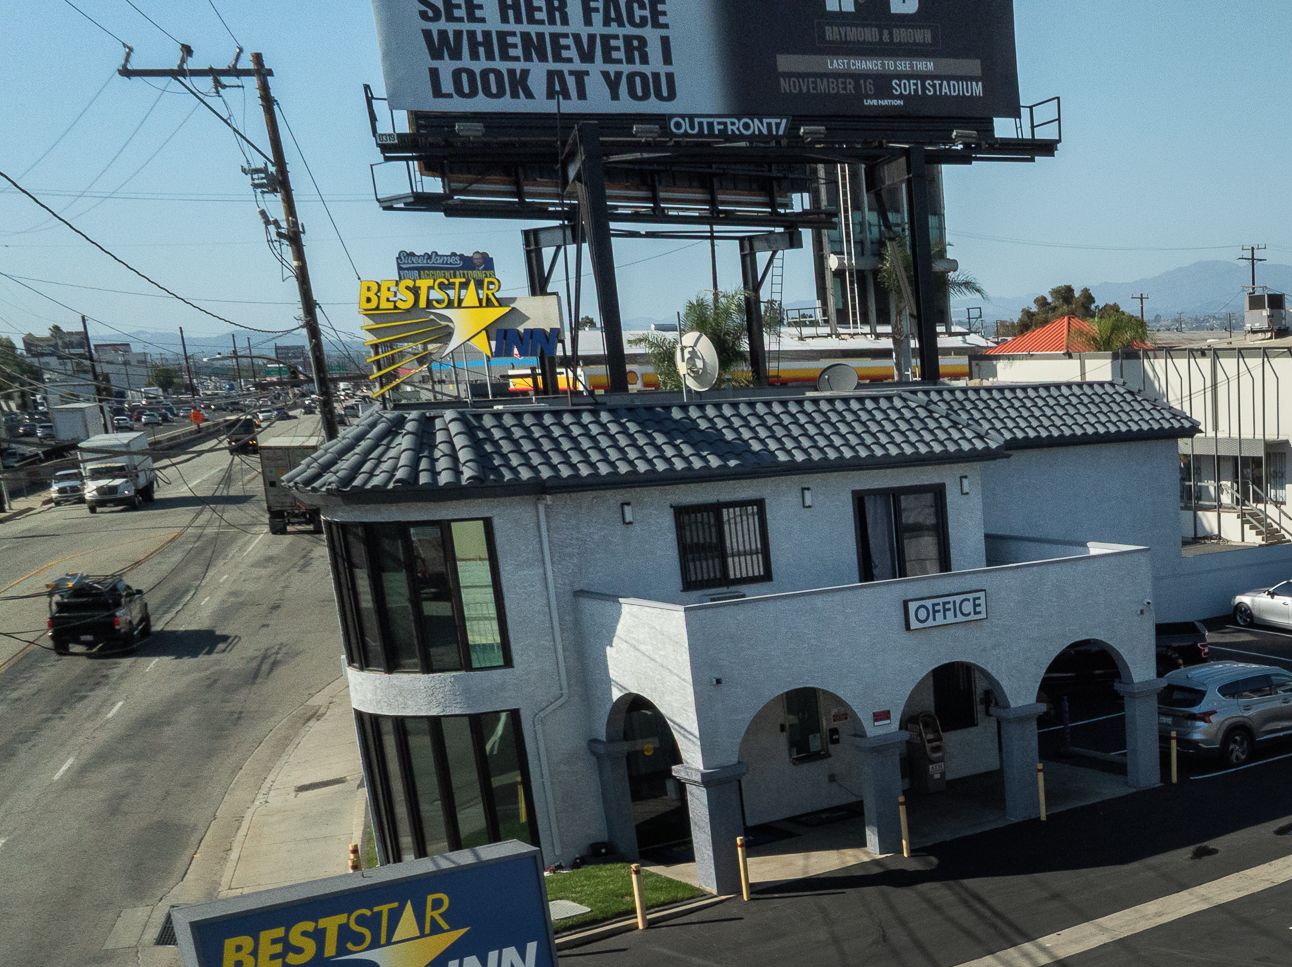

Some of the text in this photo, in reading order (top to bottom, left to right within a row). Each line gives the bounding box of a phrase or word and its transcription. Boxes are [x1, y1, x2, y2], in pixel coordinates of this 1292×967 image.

[418, 0, 670, 29] SEE HER FACE
[825, 26, 932, 44] RAYMOND & BROWN
[421, 29, 674, 66] WHENEVER I
[827, 58, 934, 72] LAST CHANCE TO SEE THEM
[428, 67, 677, 102] LOOK AT YOU
[780, 77, 983, 97] NOVEMBER 16 SOFI STADIUM
[863, 98, 904, 106] LIVE NATION
[400, 270, 419, 280] YOUR
[420, 270, 455, 279] ACCIDENT
[493, 327, 561, 358] INN
[914, 596, 982, 624] OFFICE
